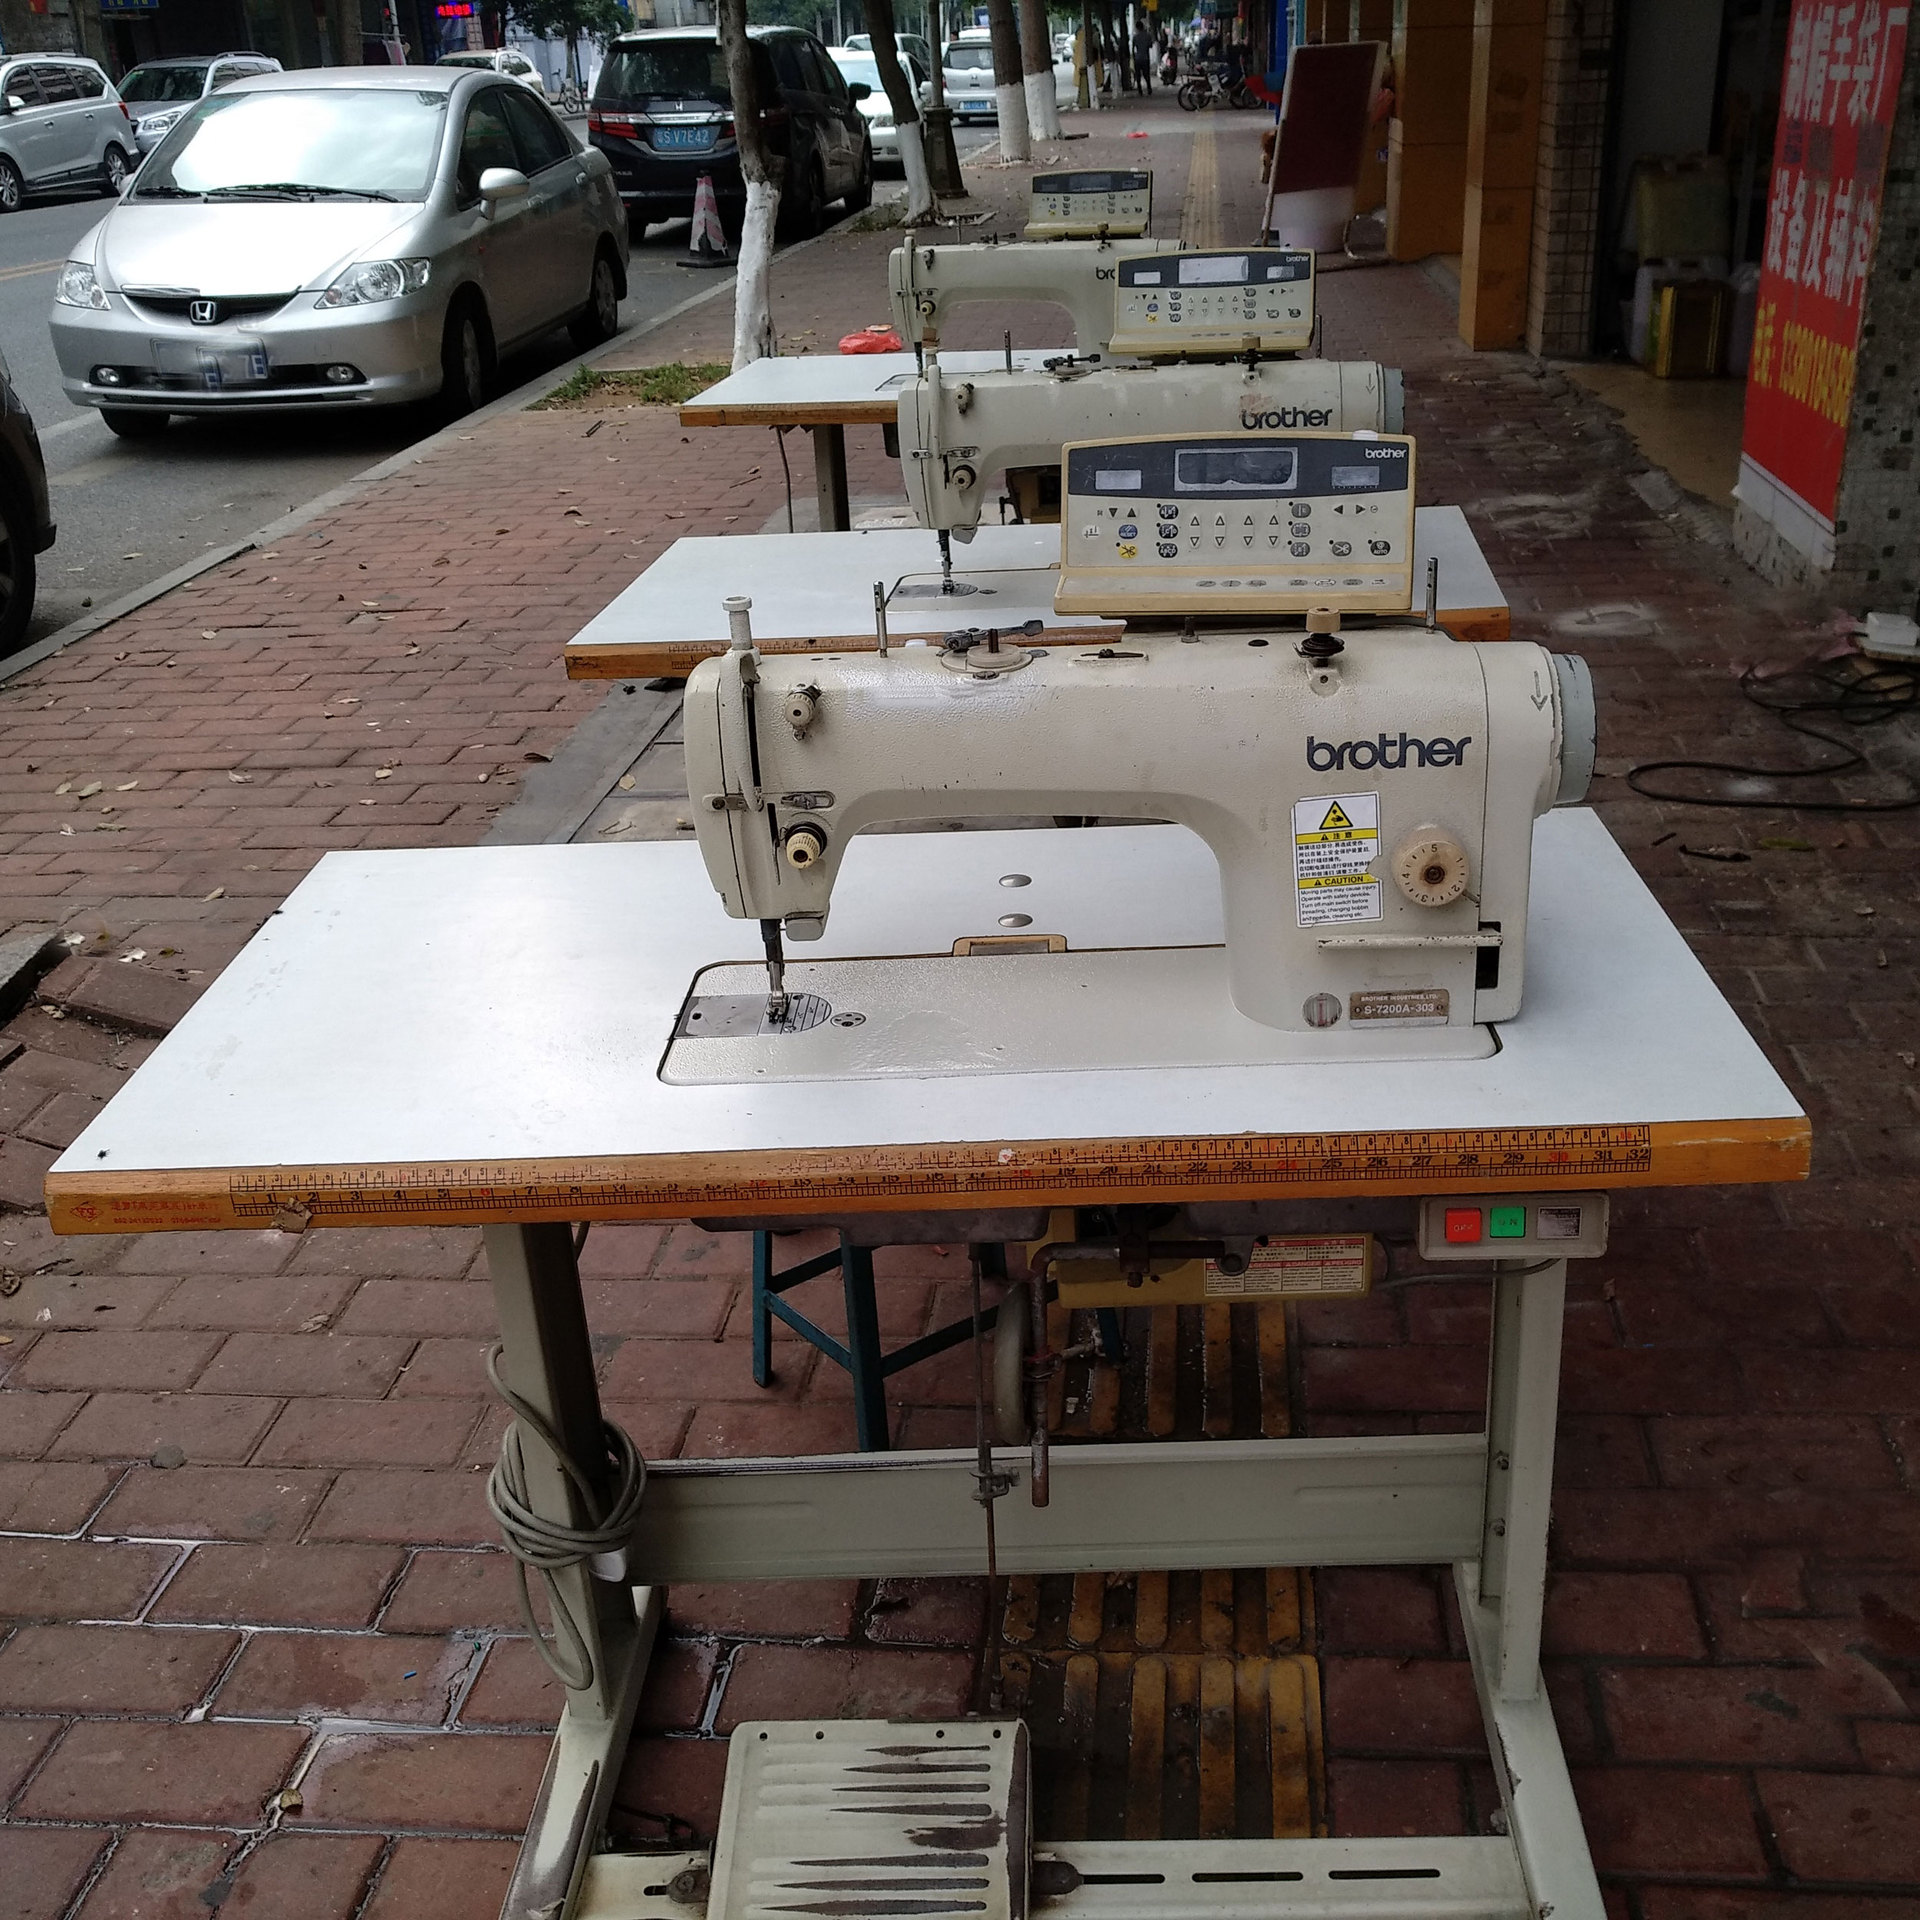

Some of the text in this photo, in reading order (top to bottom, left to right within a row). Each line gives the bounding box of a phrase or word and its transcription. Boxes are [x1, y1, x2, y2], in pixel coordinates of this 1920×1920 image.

[1286, 255, 1310, 263] brother
[1241, 407, 1333, 430] brother
[1365, 448, 1407, 459] brother
[1307, 732, 1472, 772] brother
[1431, 844, 1438, 853] 5
[1324, 876, 1364, 885] CAUTION
[1451, 885, 1460, 893] 2
[1420, 894, 1428, 903] 3
[1364, 1003, 1434, 1015] S-7200A-303
[1188, 1162, 1208, 1172] 22
[1232, 1161, 1252, 1171] 23
[1322, 1159, 1342, 1169] 25
[1368, 1157, 1388, 1167] 26
[1412, 1156, 1433, 1166] 27
[1458, 1155, 1479, 1165] 28
[1504, 1153, 1525, 1164] 29
[1549, 1152, 1568, 1162] 30
[1593, 1150, 1613, 1161] 31
[1629, 1148, 1649, 1159] 32
